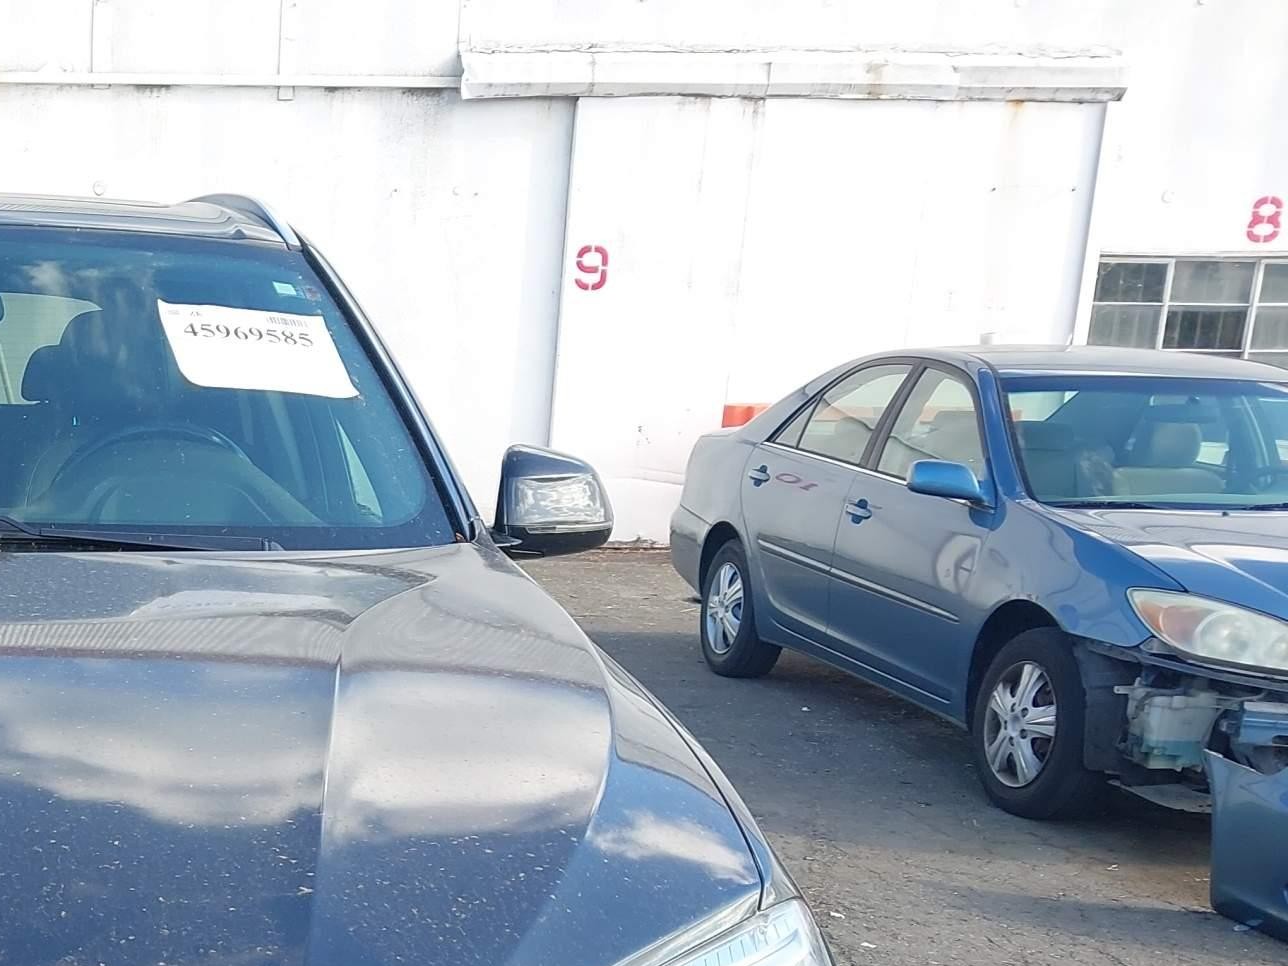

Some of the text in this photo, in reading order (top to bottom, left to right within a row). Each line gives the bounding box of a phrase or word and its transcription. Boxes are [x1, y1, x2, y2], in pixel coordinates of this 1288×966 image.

[1247, 196, 1284, 243] 8
[575, 245, 609, 291] 9
[183, 322, 314, 347] 45969585
